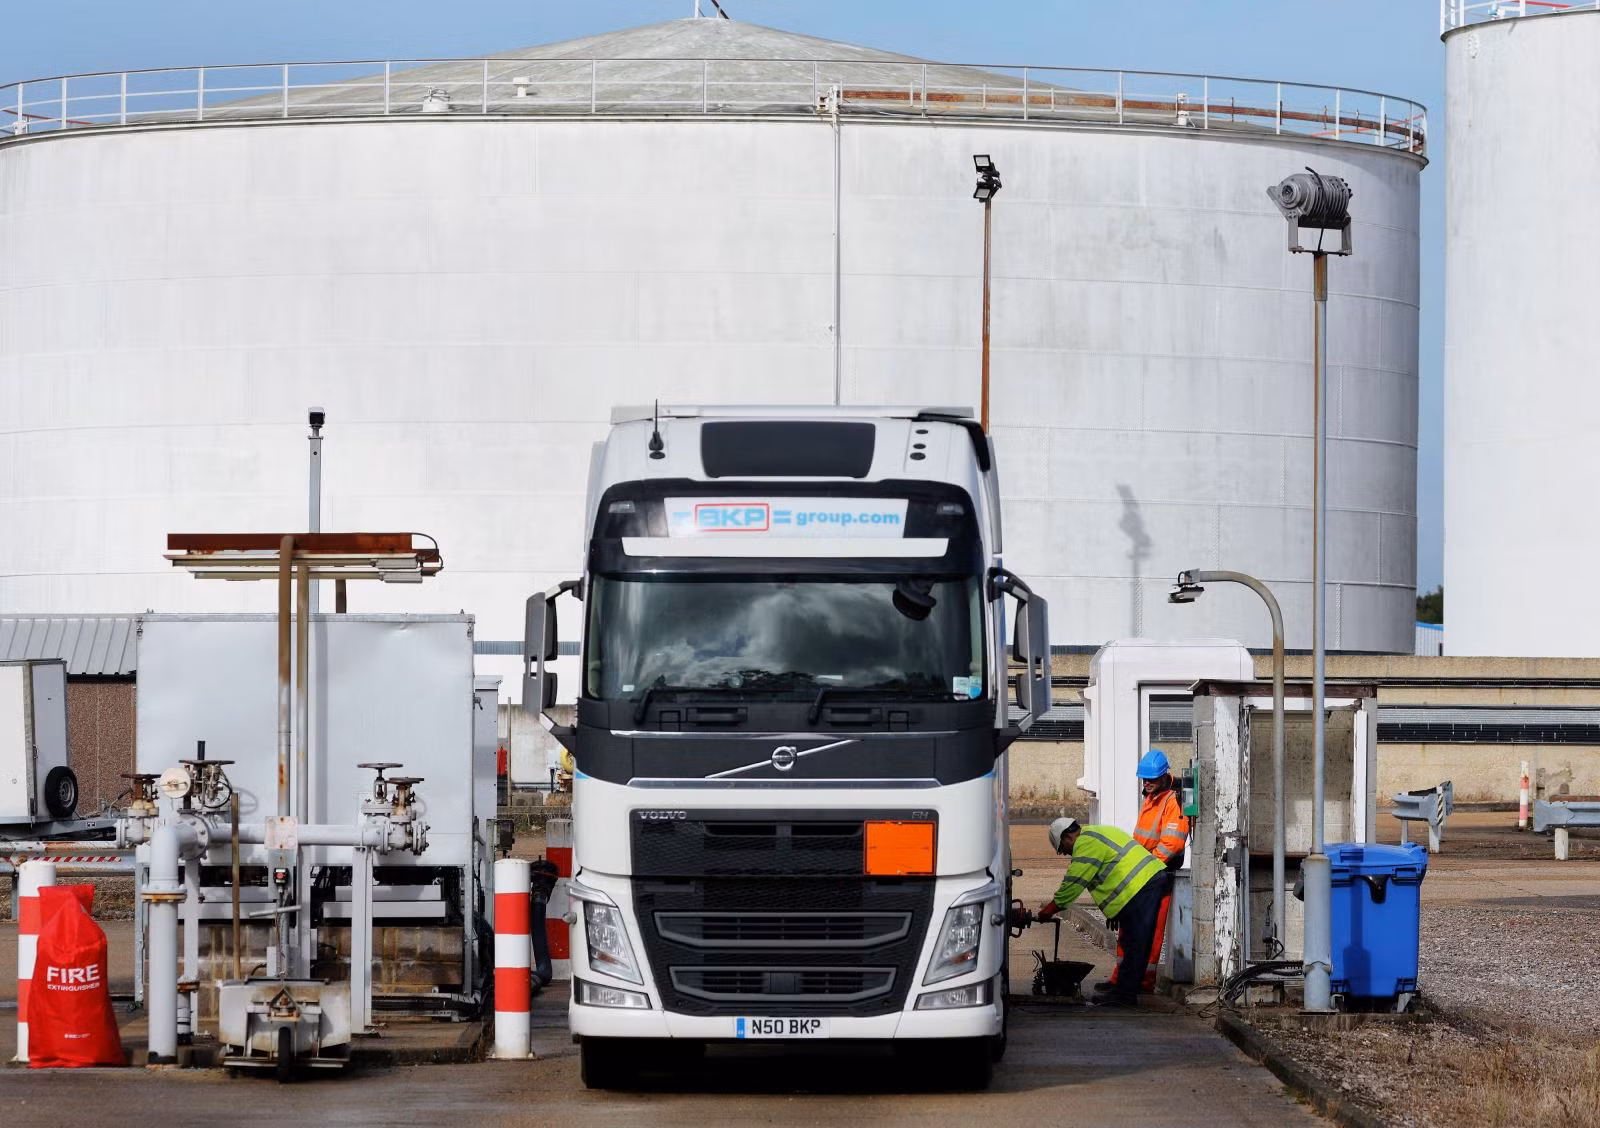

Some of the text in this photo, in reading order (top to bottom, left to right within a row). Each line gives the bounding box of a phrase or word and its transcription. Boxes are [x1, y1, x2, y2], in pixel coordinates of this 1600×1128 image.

[698, 508, 900, 527] BKP group.com
[637, 810, 687, 819] VOLVO
[46, 963, 100, 984] FIRE
[47, 982, 100, 992] EXTINGUISHER
[752, 1019, 821, 1035] N50 BKP
